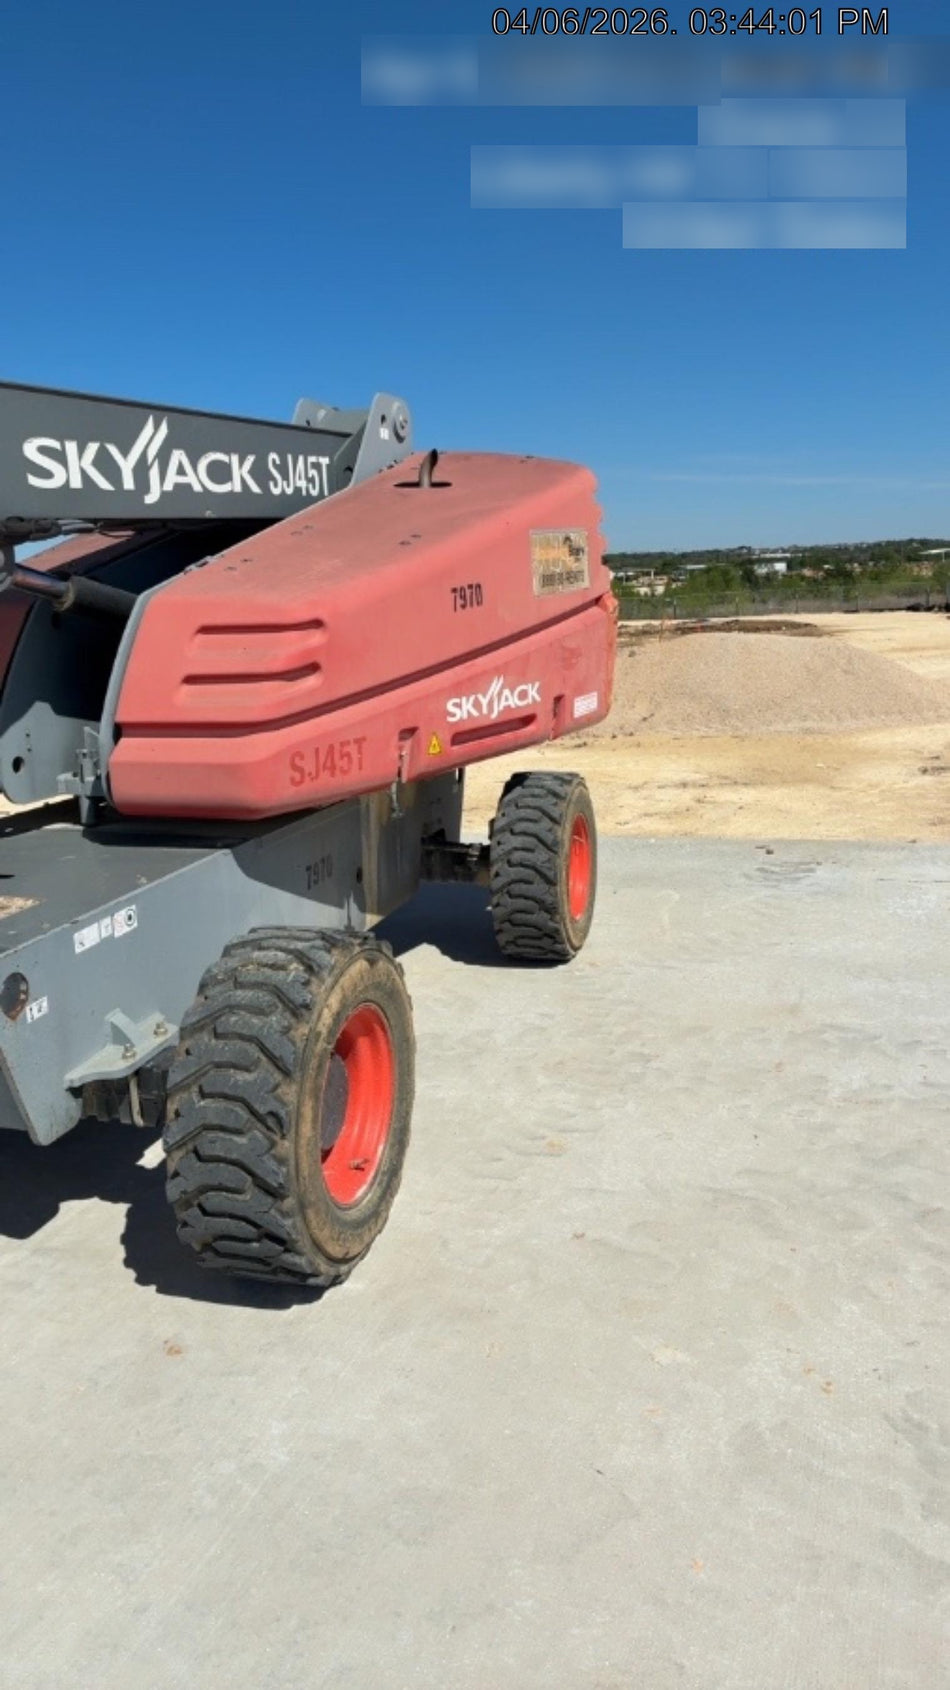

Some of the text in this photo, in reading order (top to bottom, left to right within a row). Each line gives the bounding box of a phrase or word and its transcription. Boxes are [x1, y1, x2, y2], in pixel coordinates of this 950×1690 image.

[22, 414, 330, 505] SKYJACK SJ45T
[450, 583, 483, 613] 7970
[446, 674, 541, 722] SKYJACK
[289, 736, 367, 788] SJ45T
